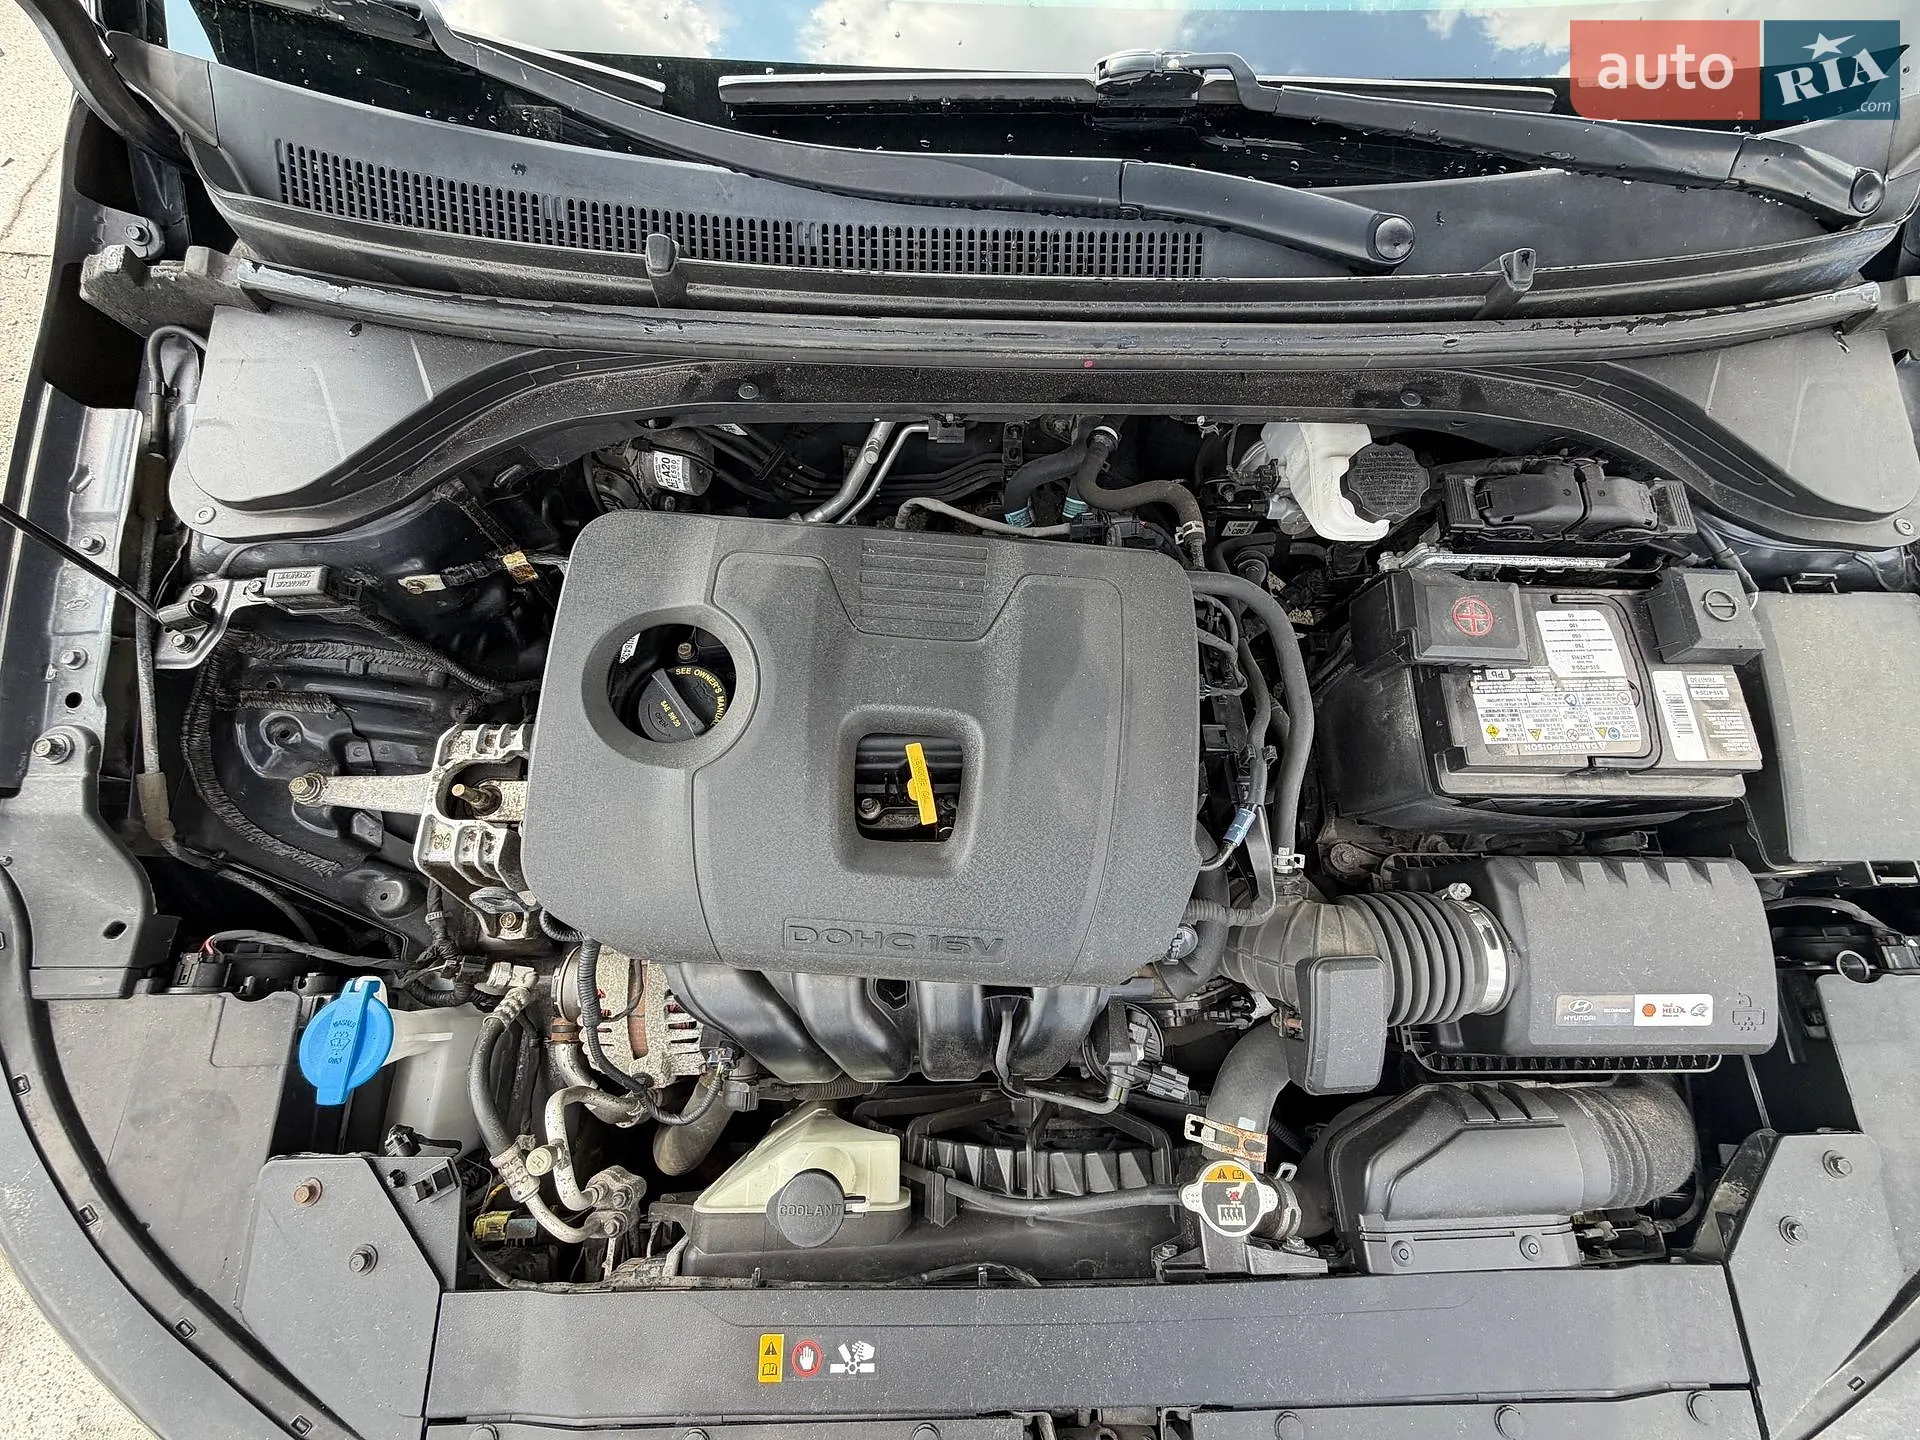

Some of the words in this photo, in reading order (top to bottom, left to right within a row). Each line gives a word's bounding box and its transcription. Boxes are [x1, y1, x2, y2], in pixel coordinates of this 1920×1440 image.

[675, 667, 692, 675] SEE
[693, 669, 723, 694] OWNER'S
[1491, 670, 1504, 678] Pb
[660, 700, 671, 712] SAE
[788, 925, 916, 950] DOHC
[928, 934, 1004, 951] 16V
[780, 1203, 843, 1217] COOLANT
